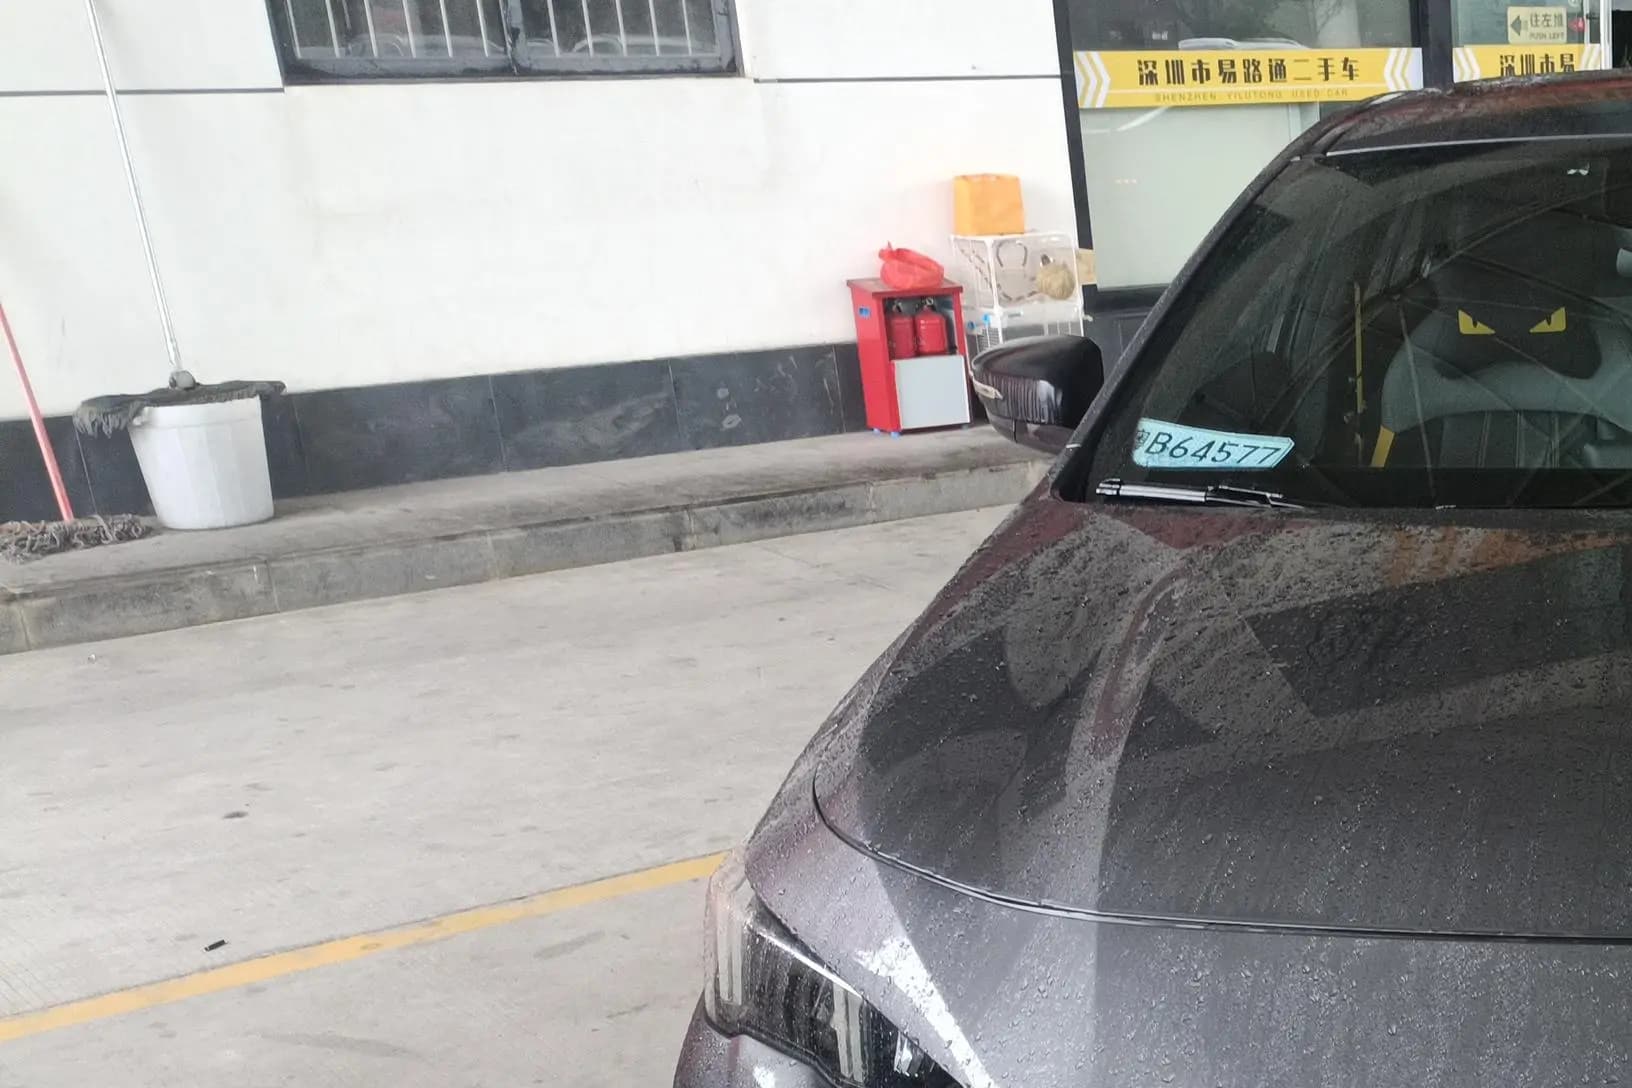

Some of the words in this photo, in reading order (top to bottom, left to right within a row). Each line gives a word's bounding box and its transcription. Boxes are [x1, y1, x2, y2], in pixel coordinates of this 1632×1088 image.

[1137, 57, 1360, 87] 深圳市易路通二手车
[1155, 92, 1217, 103] SHENZHEN
[1290, 89, 1320, 99] USED
[1326, 88, 1348, 98] CAR
